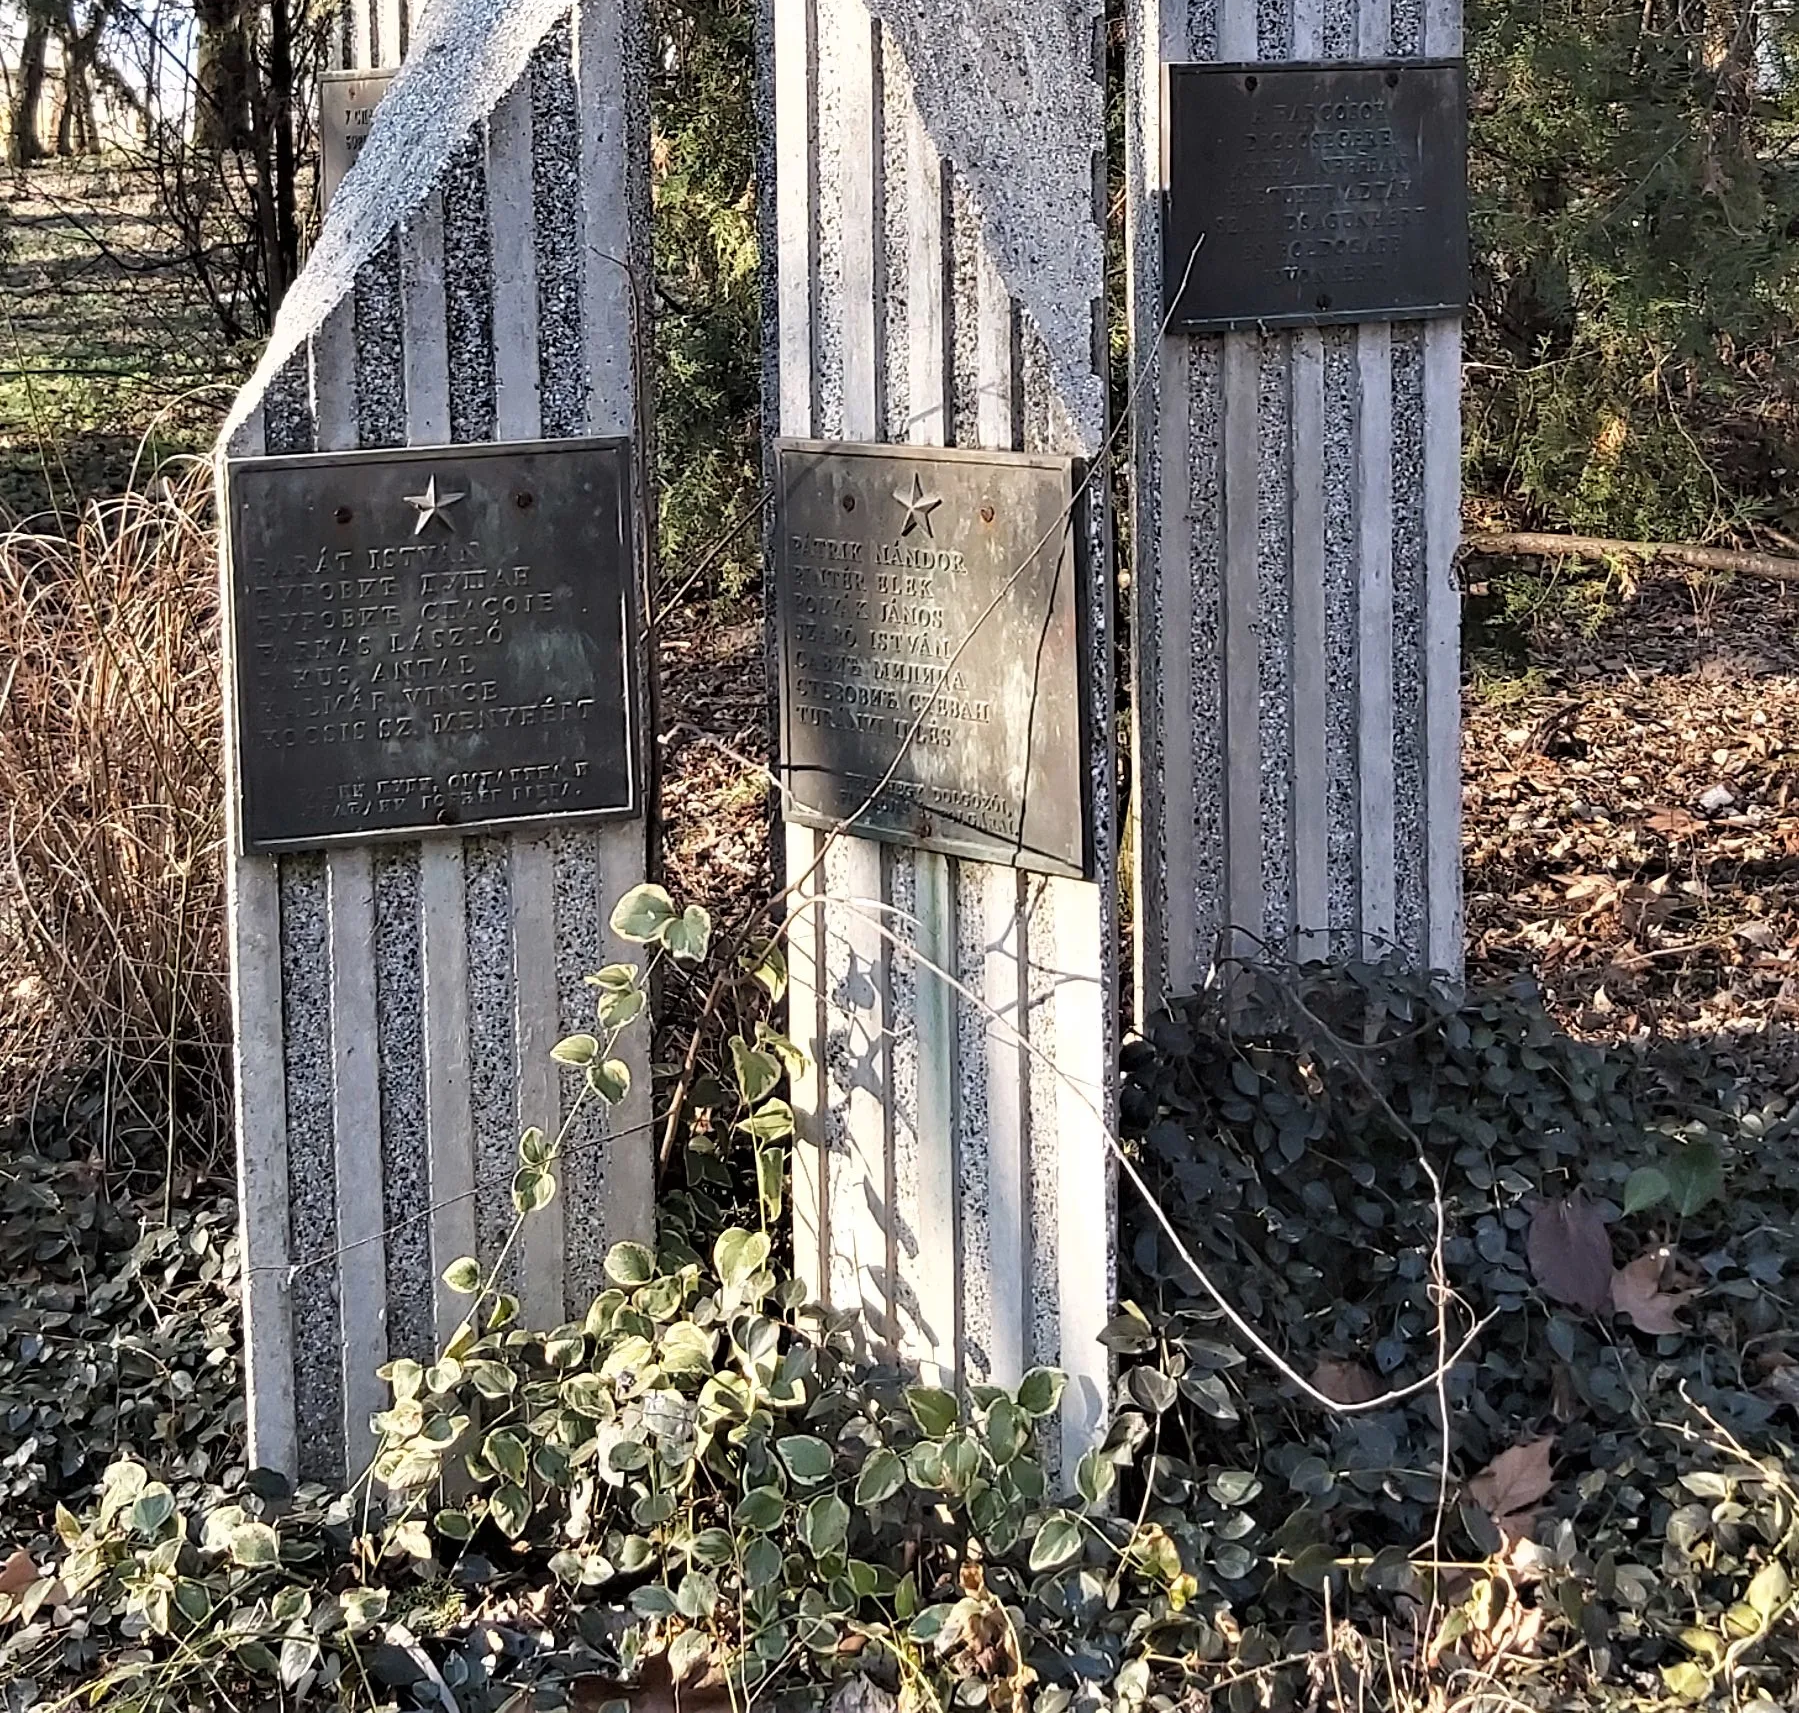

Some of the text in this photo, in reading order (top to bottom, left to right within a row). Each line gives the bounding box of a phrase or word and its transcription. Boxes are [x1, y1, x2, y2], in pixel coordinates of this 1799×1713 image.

[252, 540, 481, 578] BARÁT ISTVÁN
[874, 539, 970, 576] NÁNDOR
[876, 571, 935, 600] ELEK
[880, 597, 945, 629] JÁNOS
[390, 618, 503, 653] LÁSZLÓ
[868, 627, 953, 661] ISTVÁN
[370, 652, 477, 684] ANTAL
[402, 679, 499, 709] VINCE
[258, 719, 367, 751] KOCSIS
[432, 695, 597, 735] MENYHÉRT
